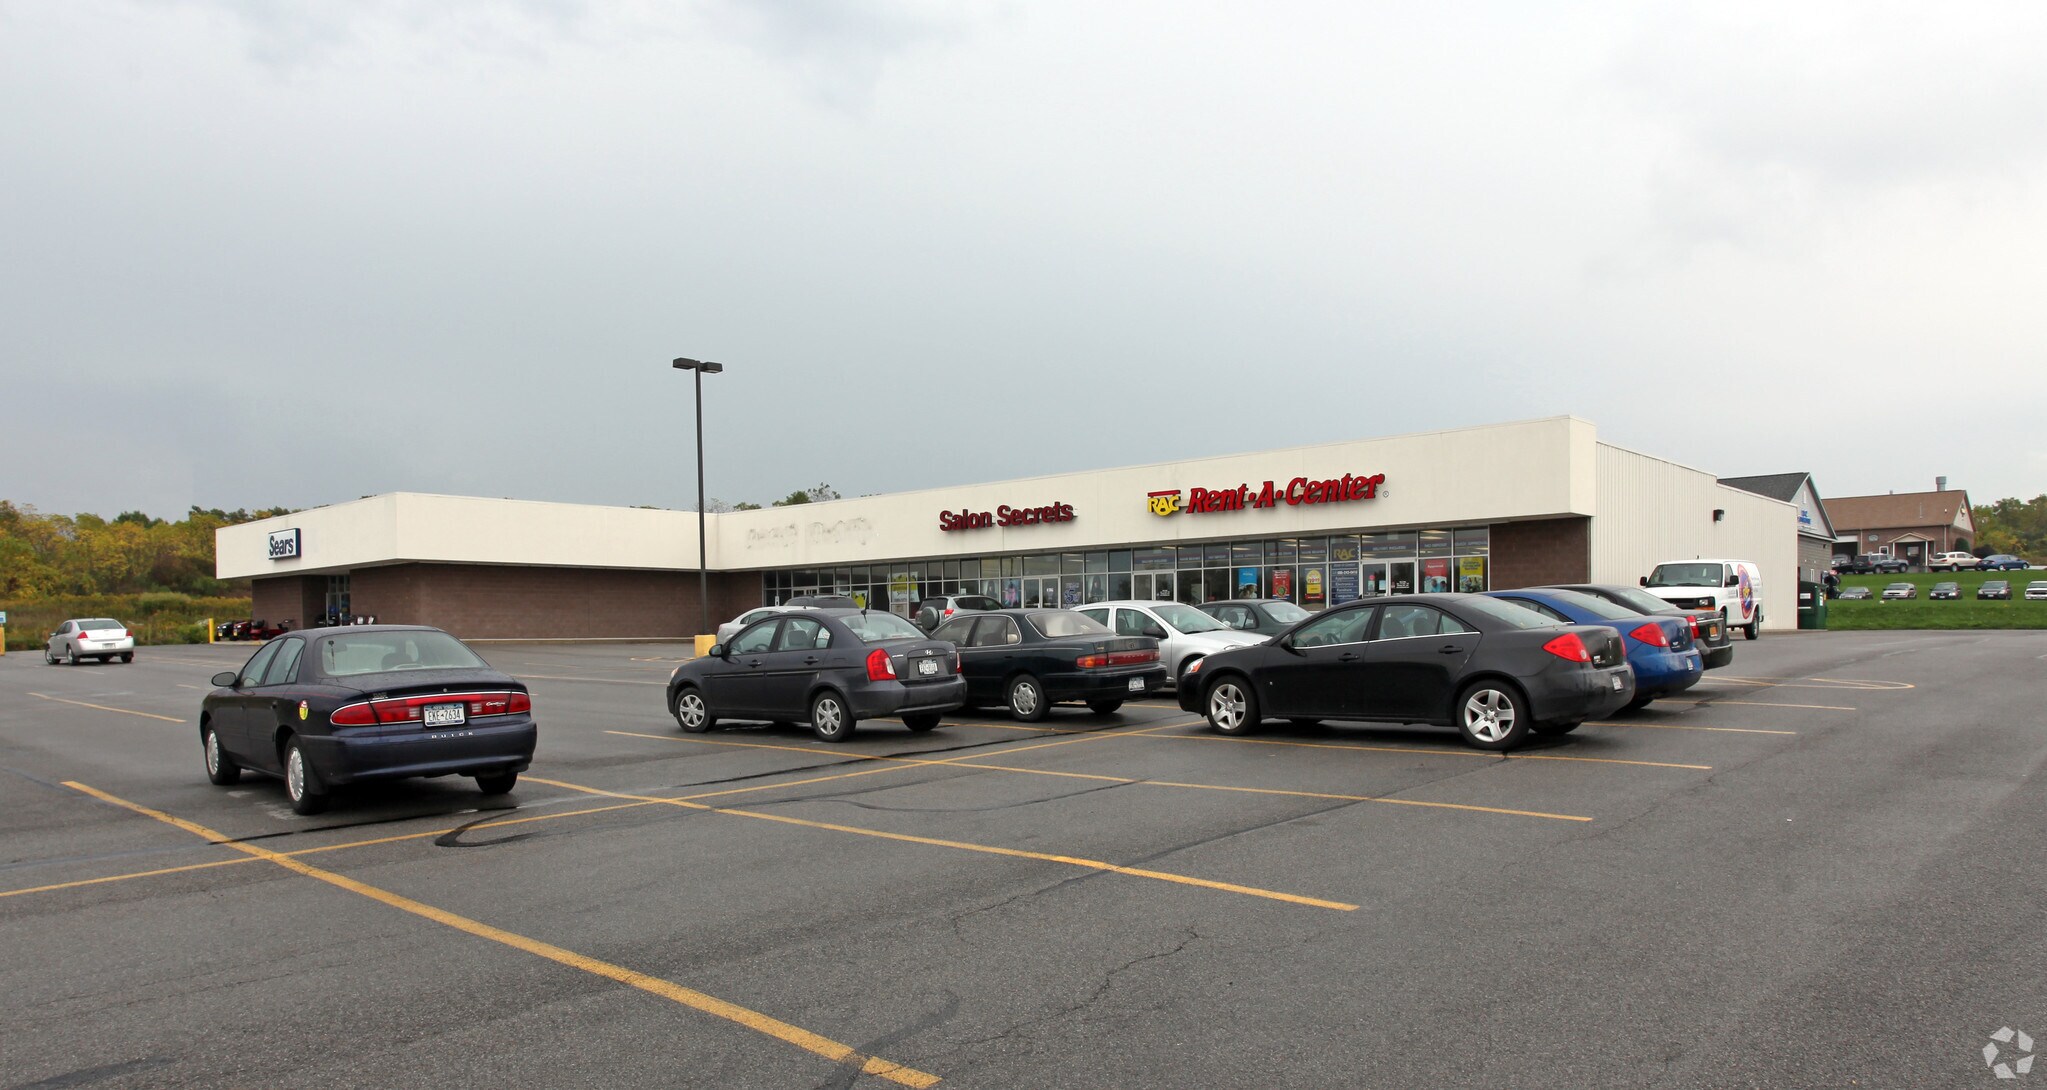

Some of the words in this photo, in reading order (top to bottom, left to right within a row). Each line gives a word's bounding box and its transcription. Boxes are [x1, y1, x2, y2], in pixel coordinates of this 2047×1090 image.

[939, 508, 993, 531] Salon
[997, 501, 1073, 526] Secrets
[1147, 495, 1181, 516] RAC
[269, 535, 294, 556] Sears
[1333, 548, 1356, 561] RAC
